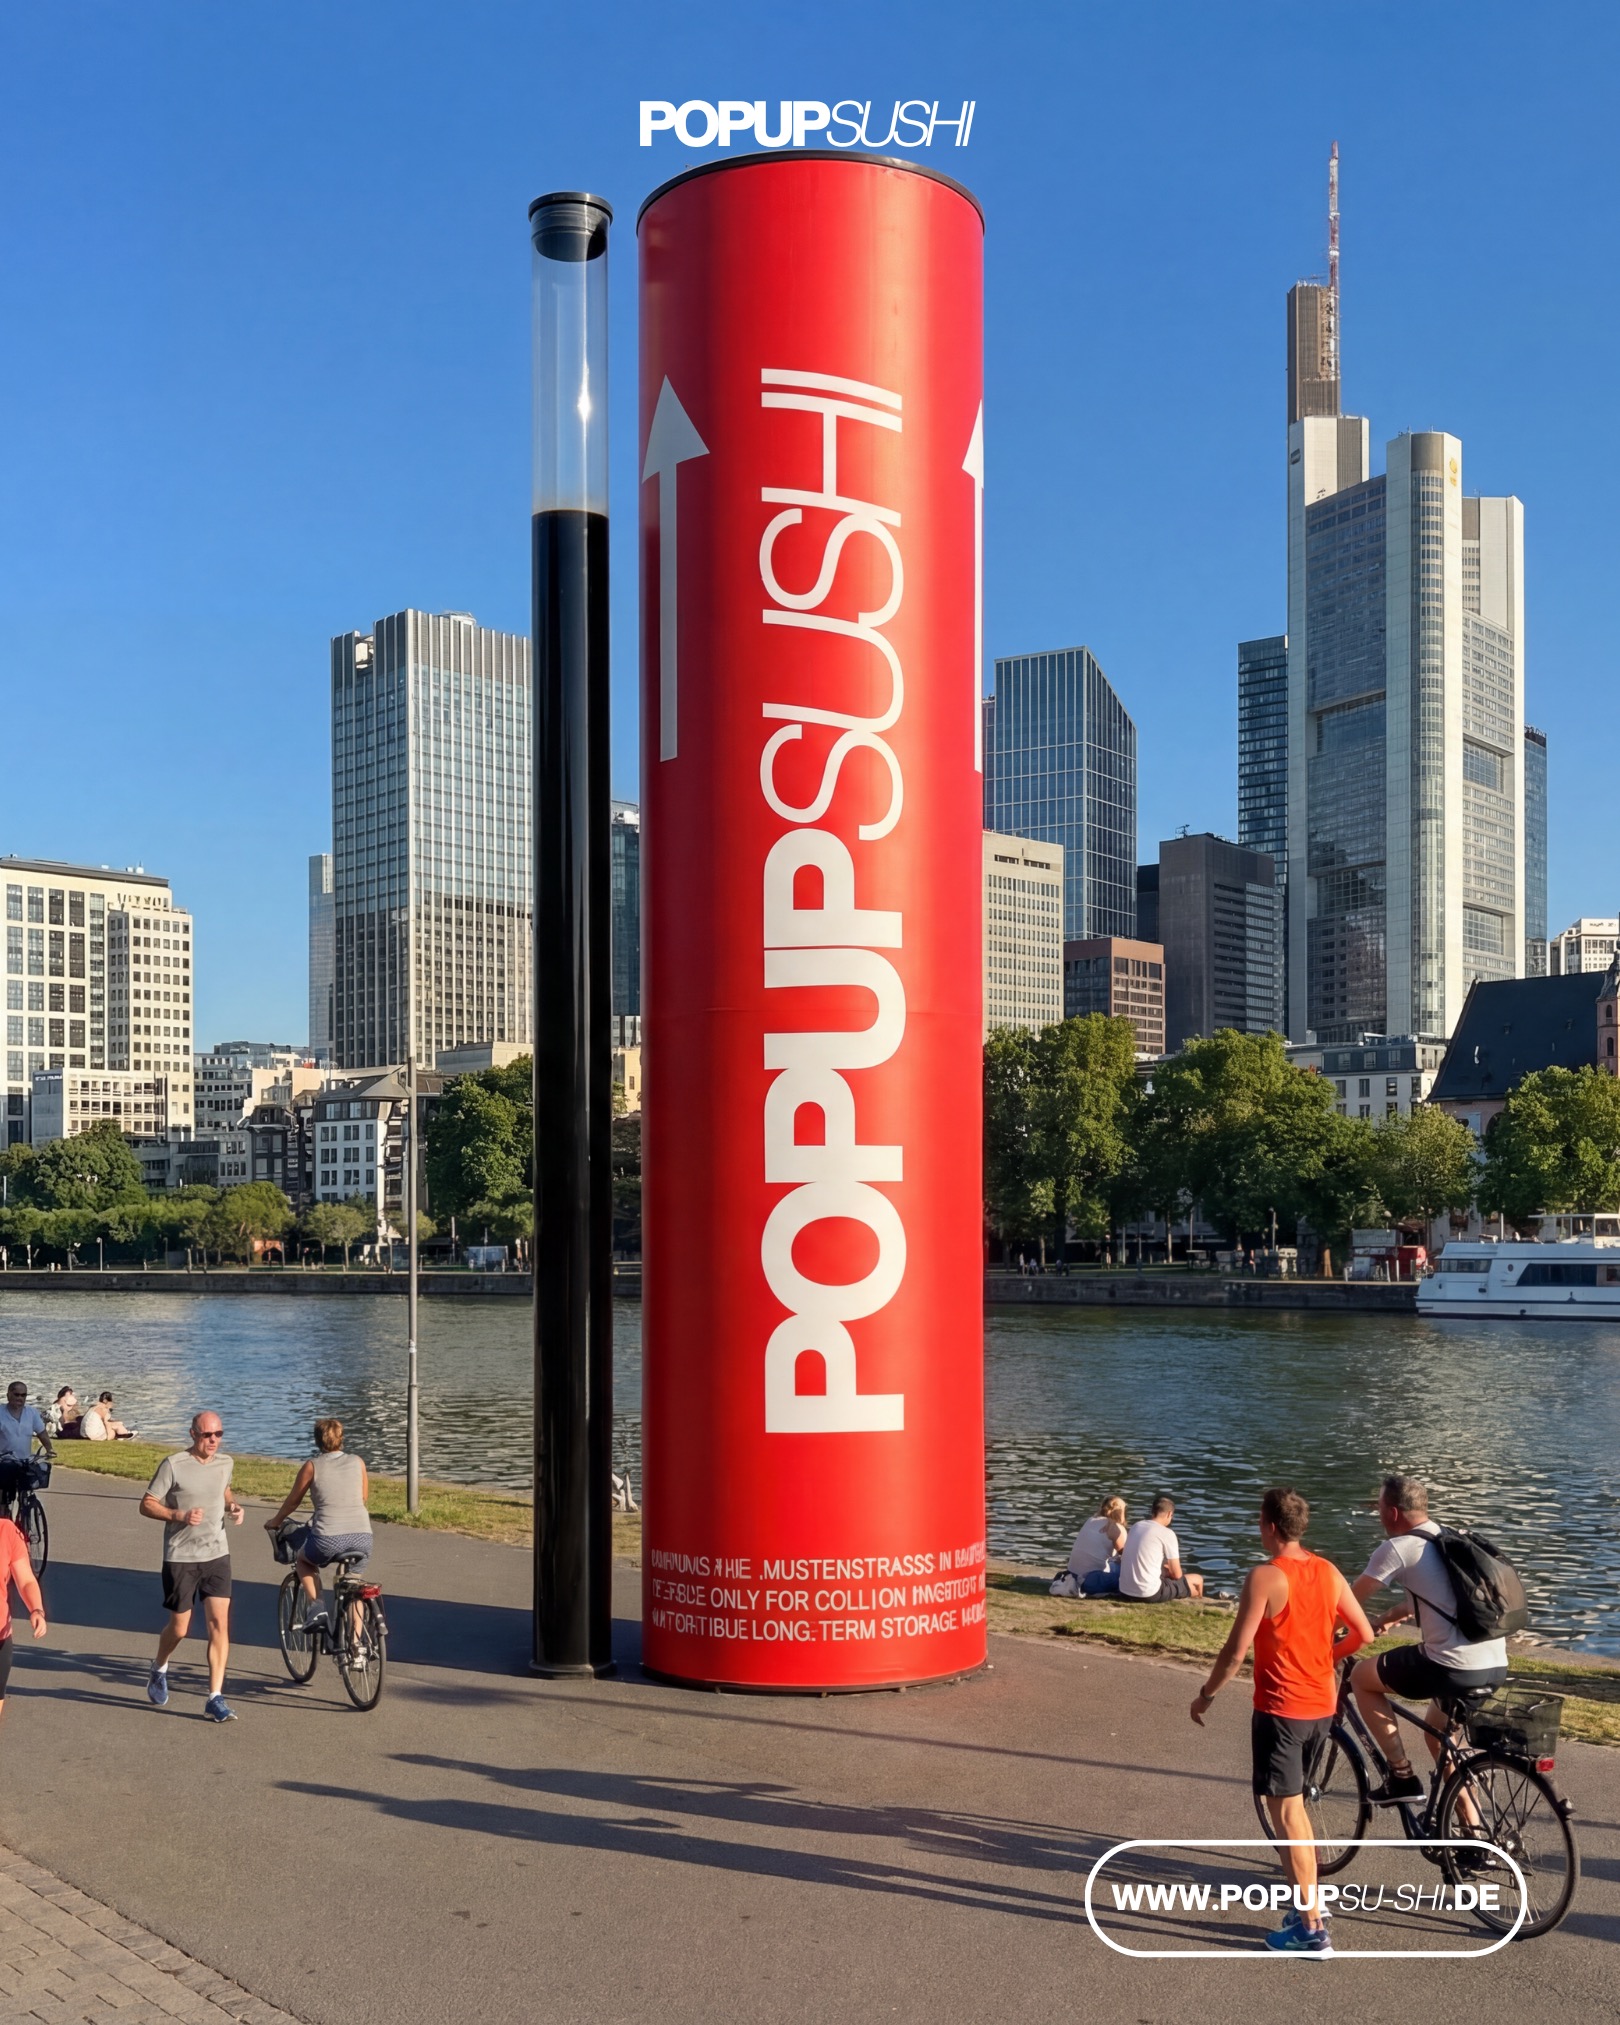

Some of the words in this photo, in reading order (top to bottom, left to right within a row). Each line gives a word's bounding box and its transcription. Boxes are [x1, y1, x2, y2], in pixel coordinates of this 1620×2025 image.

[759, 367, 906, 1434] POPUPSUSHI
[939, 1551, 951, 1571] IN
[710, 1587, 760, 1610] ONLY
[766, 1590, 809, 1611] FOR
[819, 1620, 876, 1641] TERM
